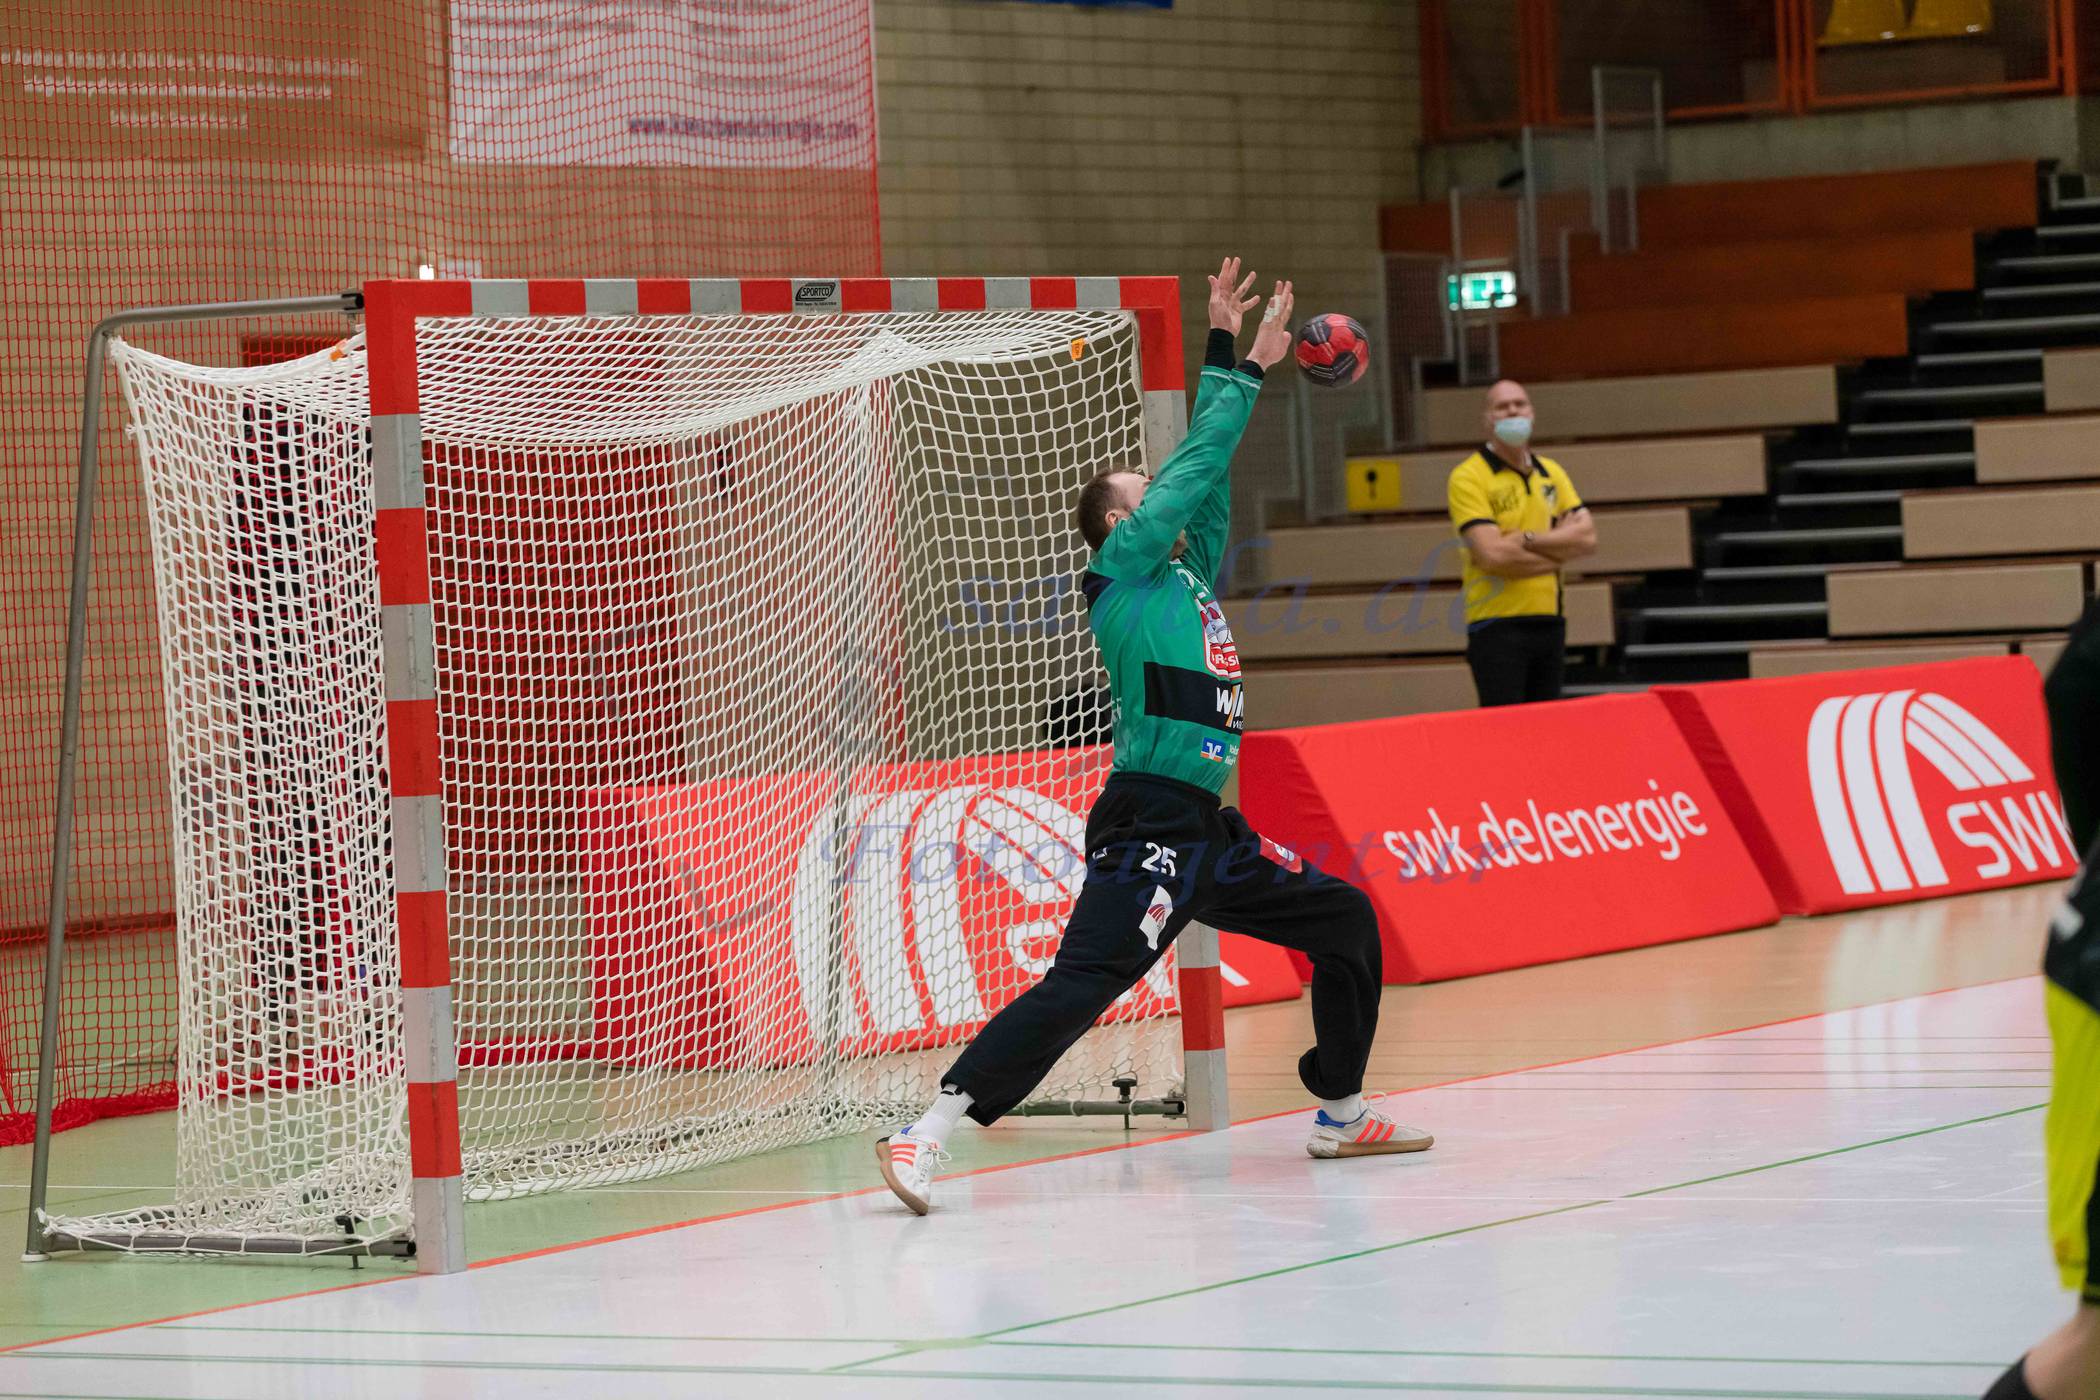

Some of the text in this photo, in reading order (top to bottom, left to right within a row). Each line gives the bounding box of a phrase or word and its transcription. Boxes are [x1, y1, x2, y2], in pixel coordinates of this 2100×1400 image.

[801, 287, 830, 297] SPORTCO
[1383, 778, 1708, 878] swk.de/energie
[1141, 842, 1177, 877] 25
